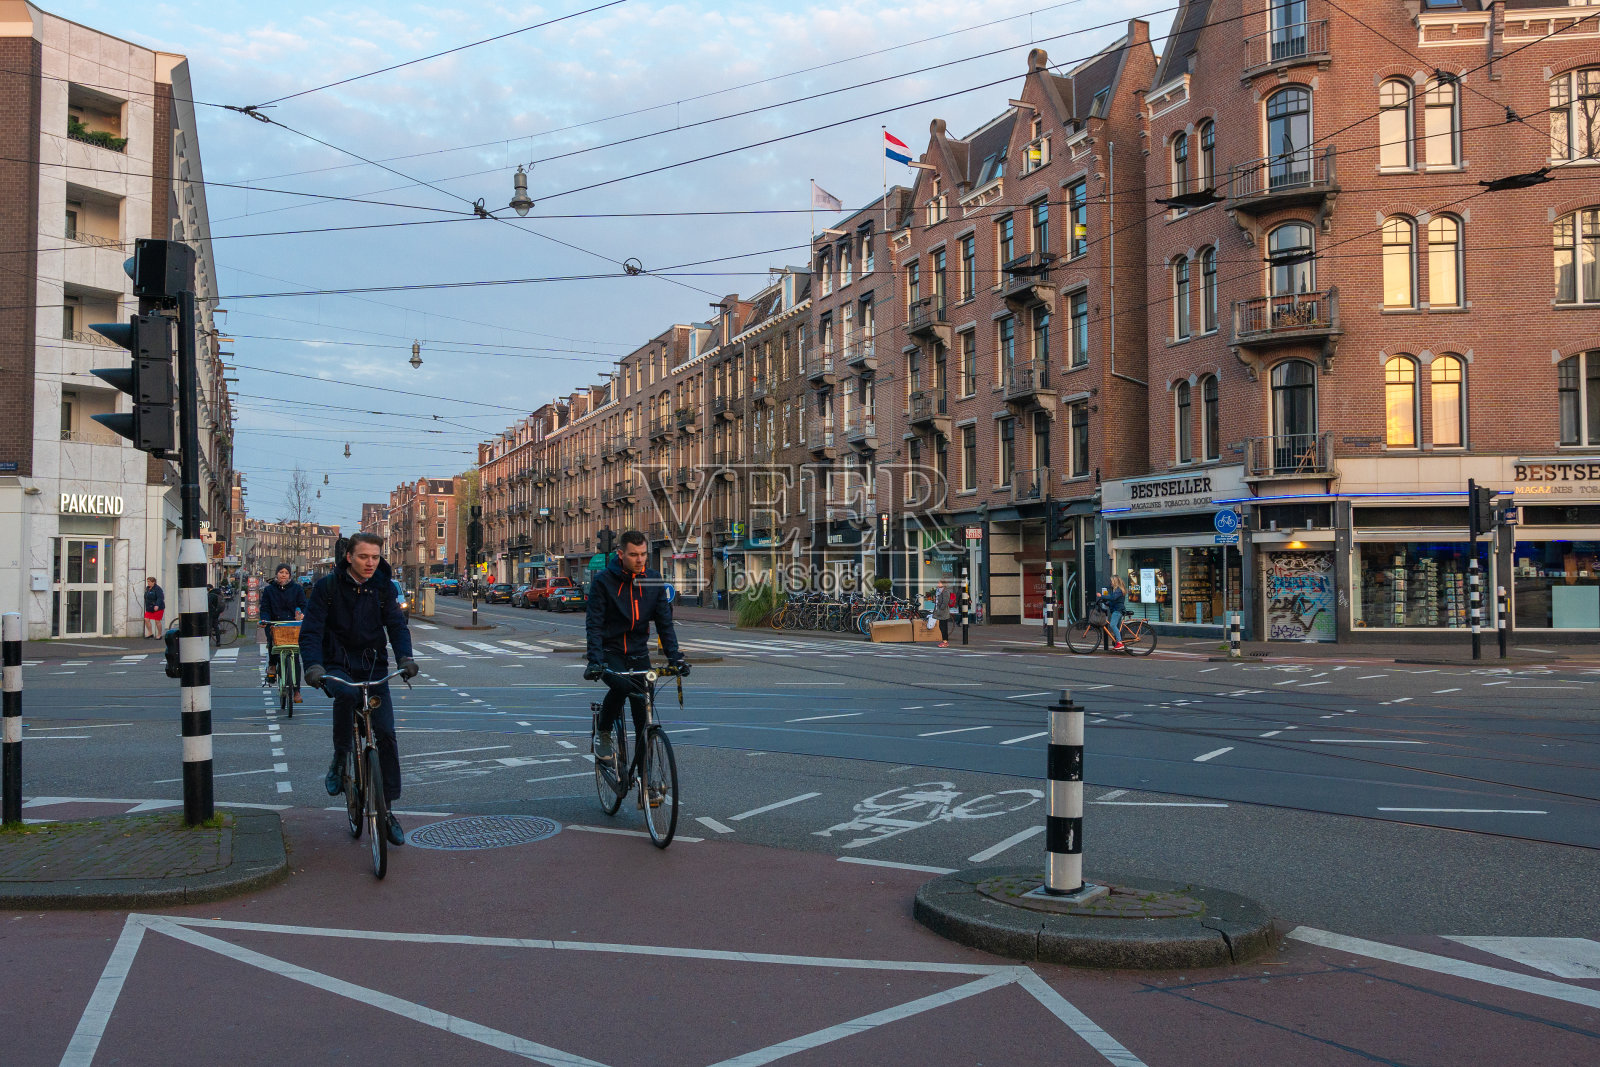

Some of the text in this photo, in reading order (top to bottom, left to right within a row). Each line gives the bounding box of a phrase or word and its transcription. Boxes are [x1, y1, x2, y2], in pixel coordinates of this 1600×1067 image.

[1130, 477, 1212, 499] BESTSELLER
[1515, 486, 1573, 494] MAGAZINES
[60, 493, 124, 515] PAKKEND
[1131, 501, 1161, 510] MAGAZINES
[1164, 499, 1190, 508] TOBACCO
